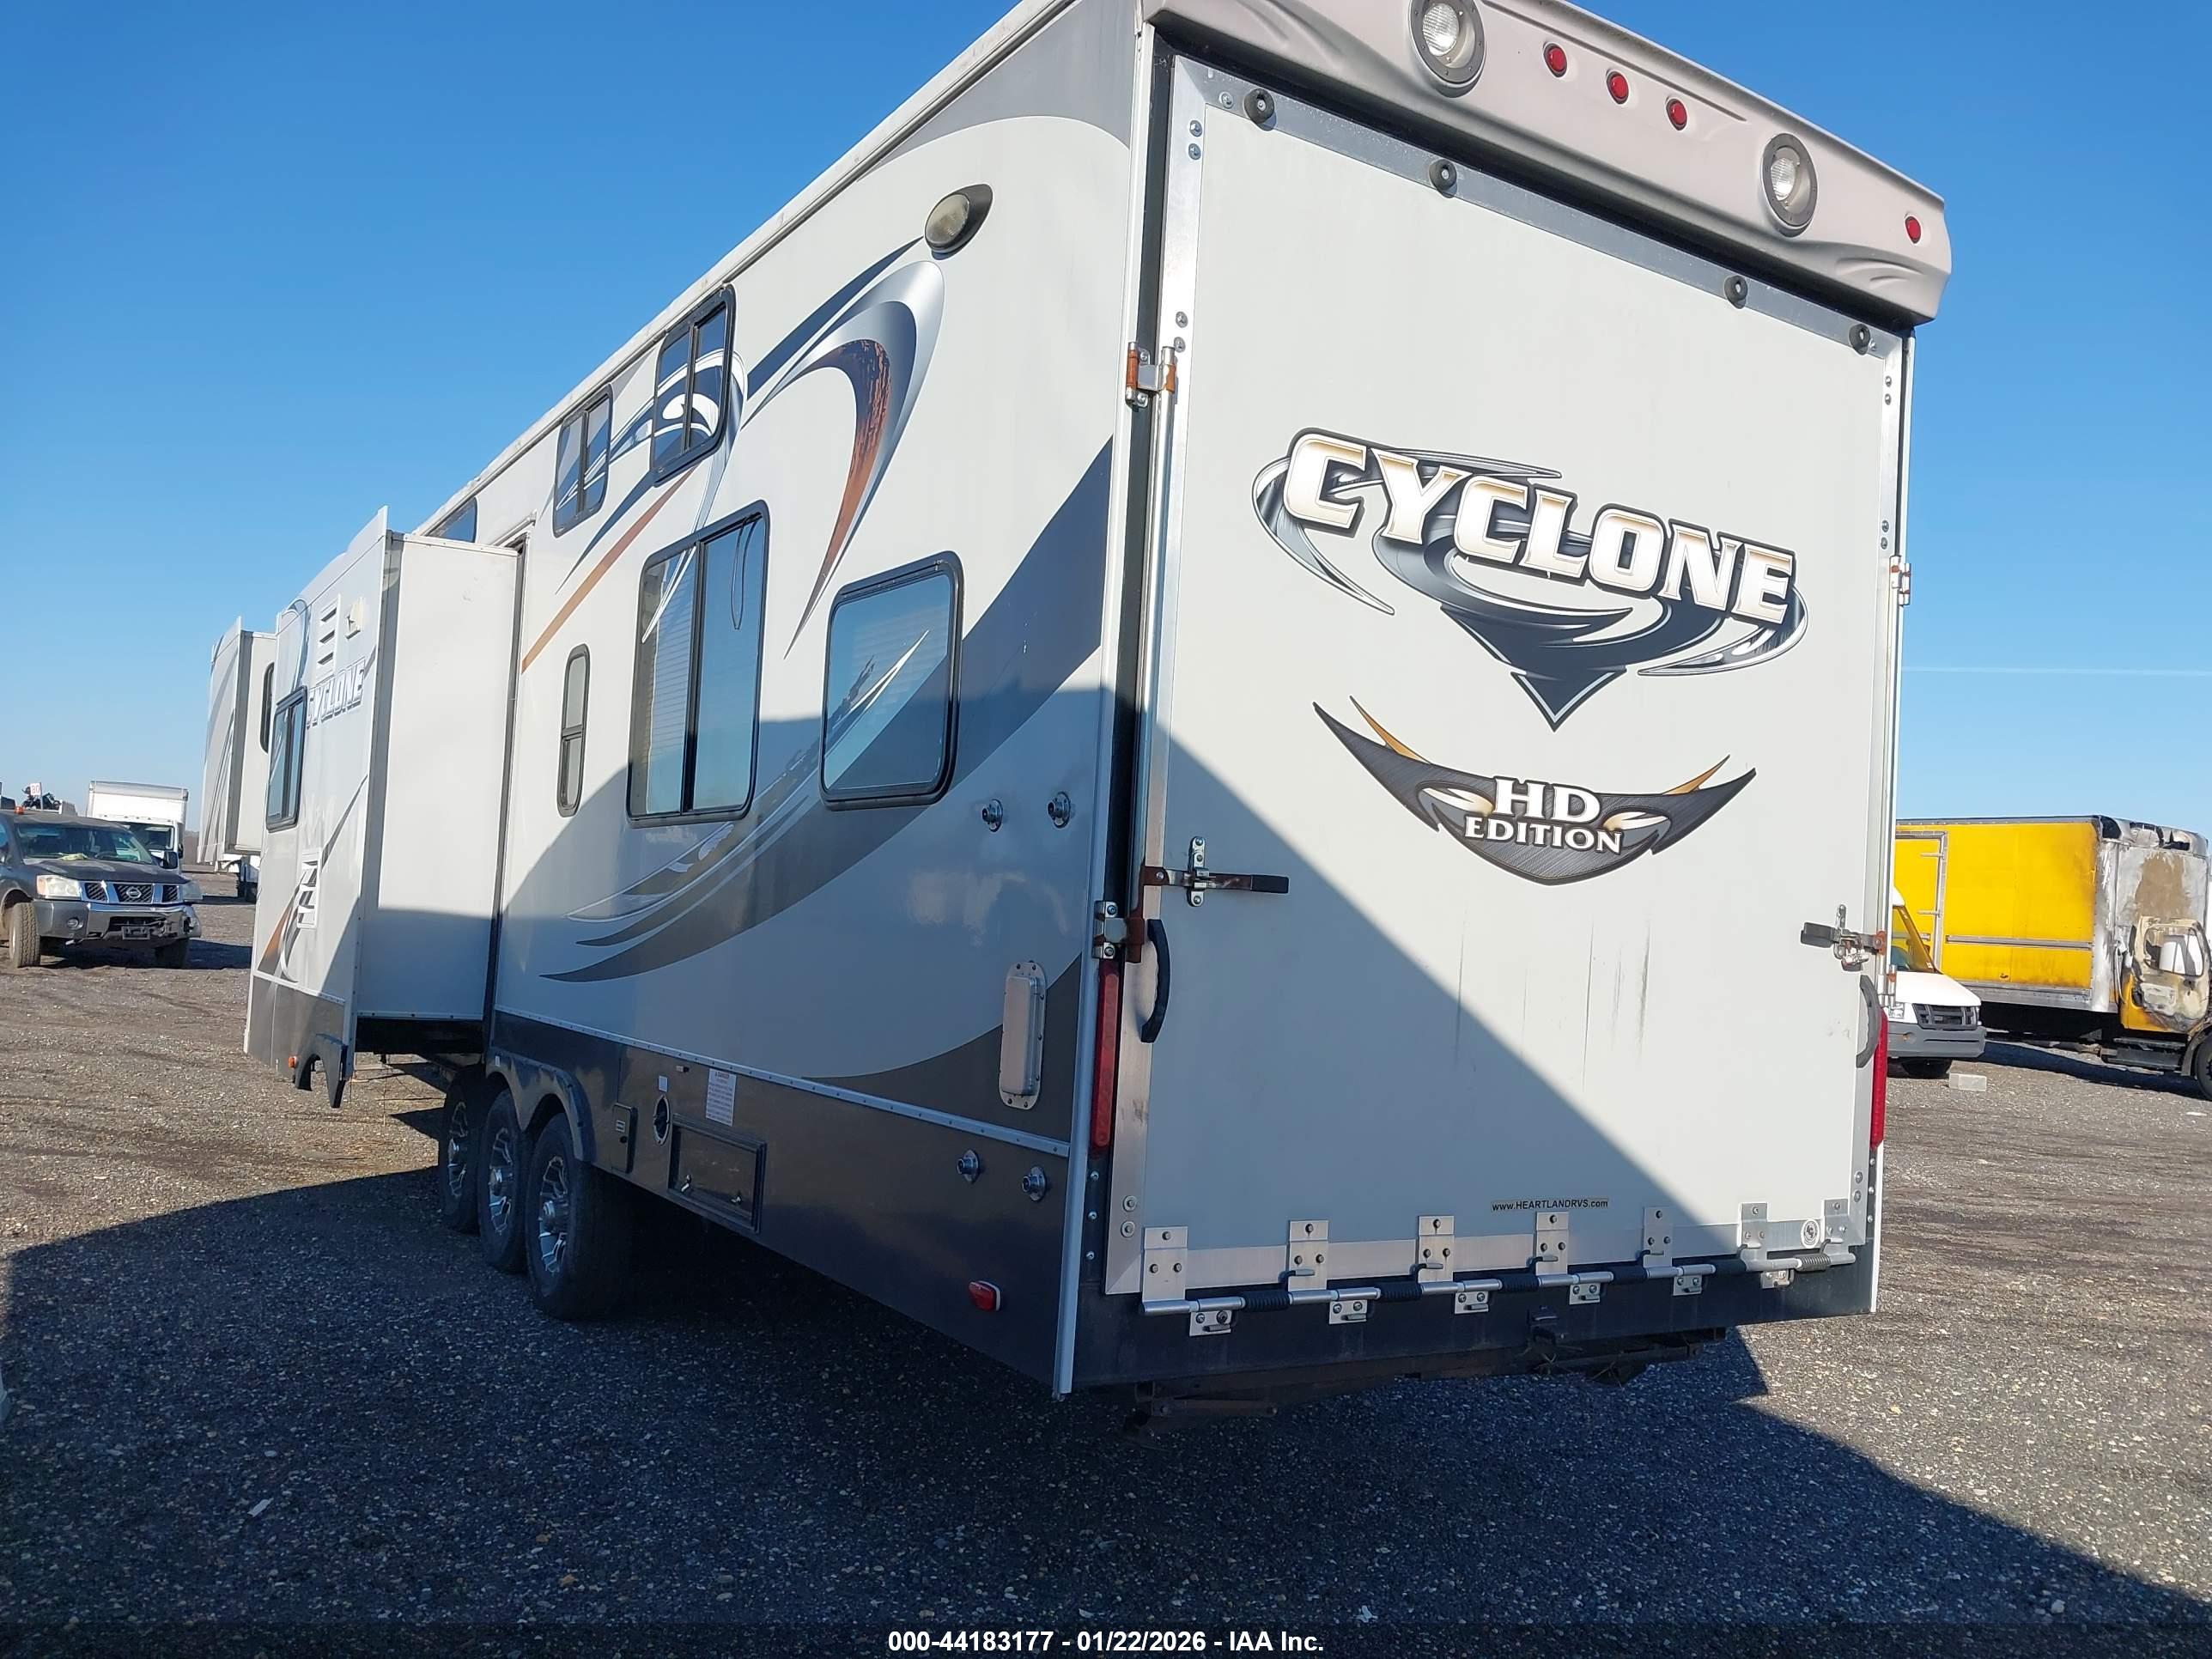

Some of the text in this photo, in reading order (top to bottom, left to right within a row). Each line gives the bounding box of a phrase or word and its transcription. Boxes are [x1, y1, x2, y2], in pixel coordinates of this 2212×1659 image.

[1283, 433, 1796, 624] CYCLONE
[1492, 777, 1601, 823] HD
[1464, 816, 1622, 854] EDITION
[1492, 1199, 1608, 1212] www.HEARTLANDRVS.com
